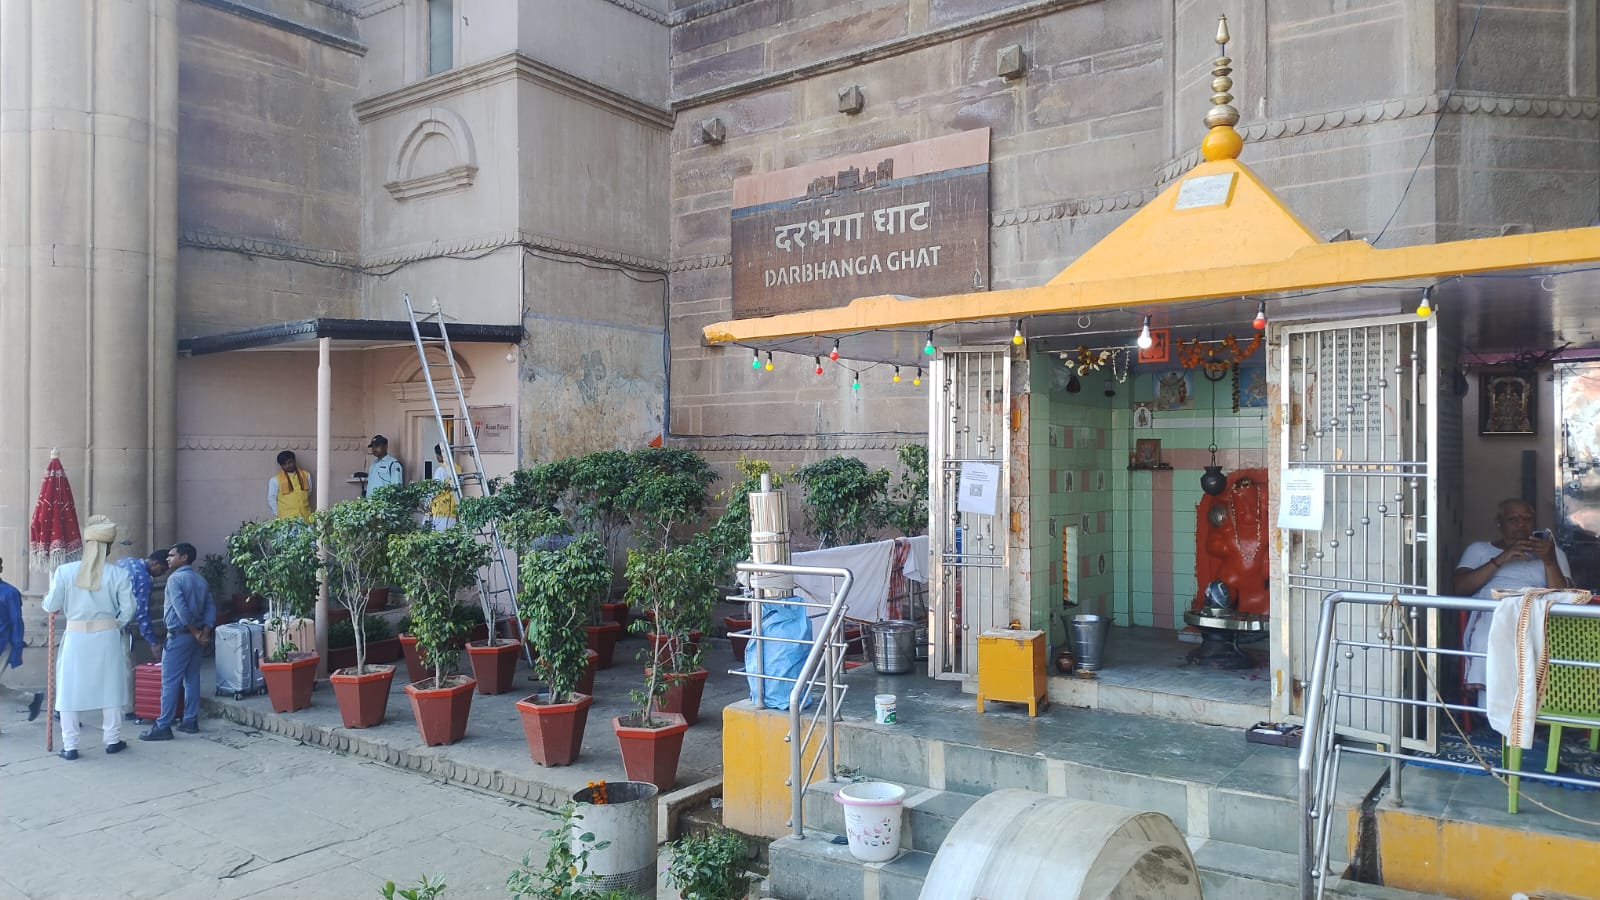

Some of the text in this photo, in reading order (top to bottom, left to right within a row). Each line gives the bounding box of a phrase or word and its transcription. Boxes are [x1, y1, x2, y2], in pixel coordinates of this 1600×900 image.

[775, 202, 930, 252] दरभंगा घाट
[765, 246, 941, 287] DARBHANGA GHAT
